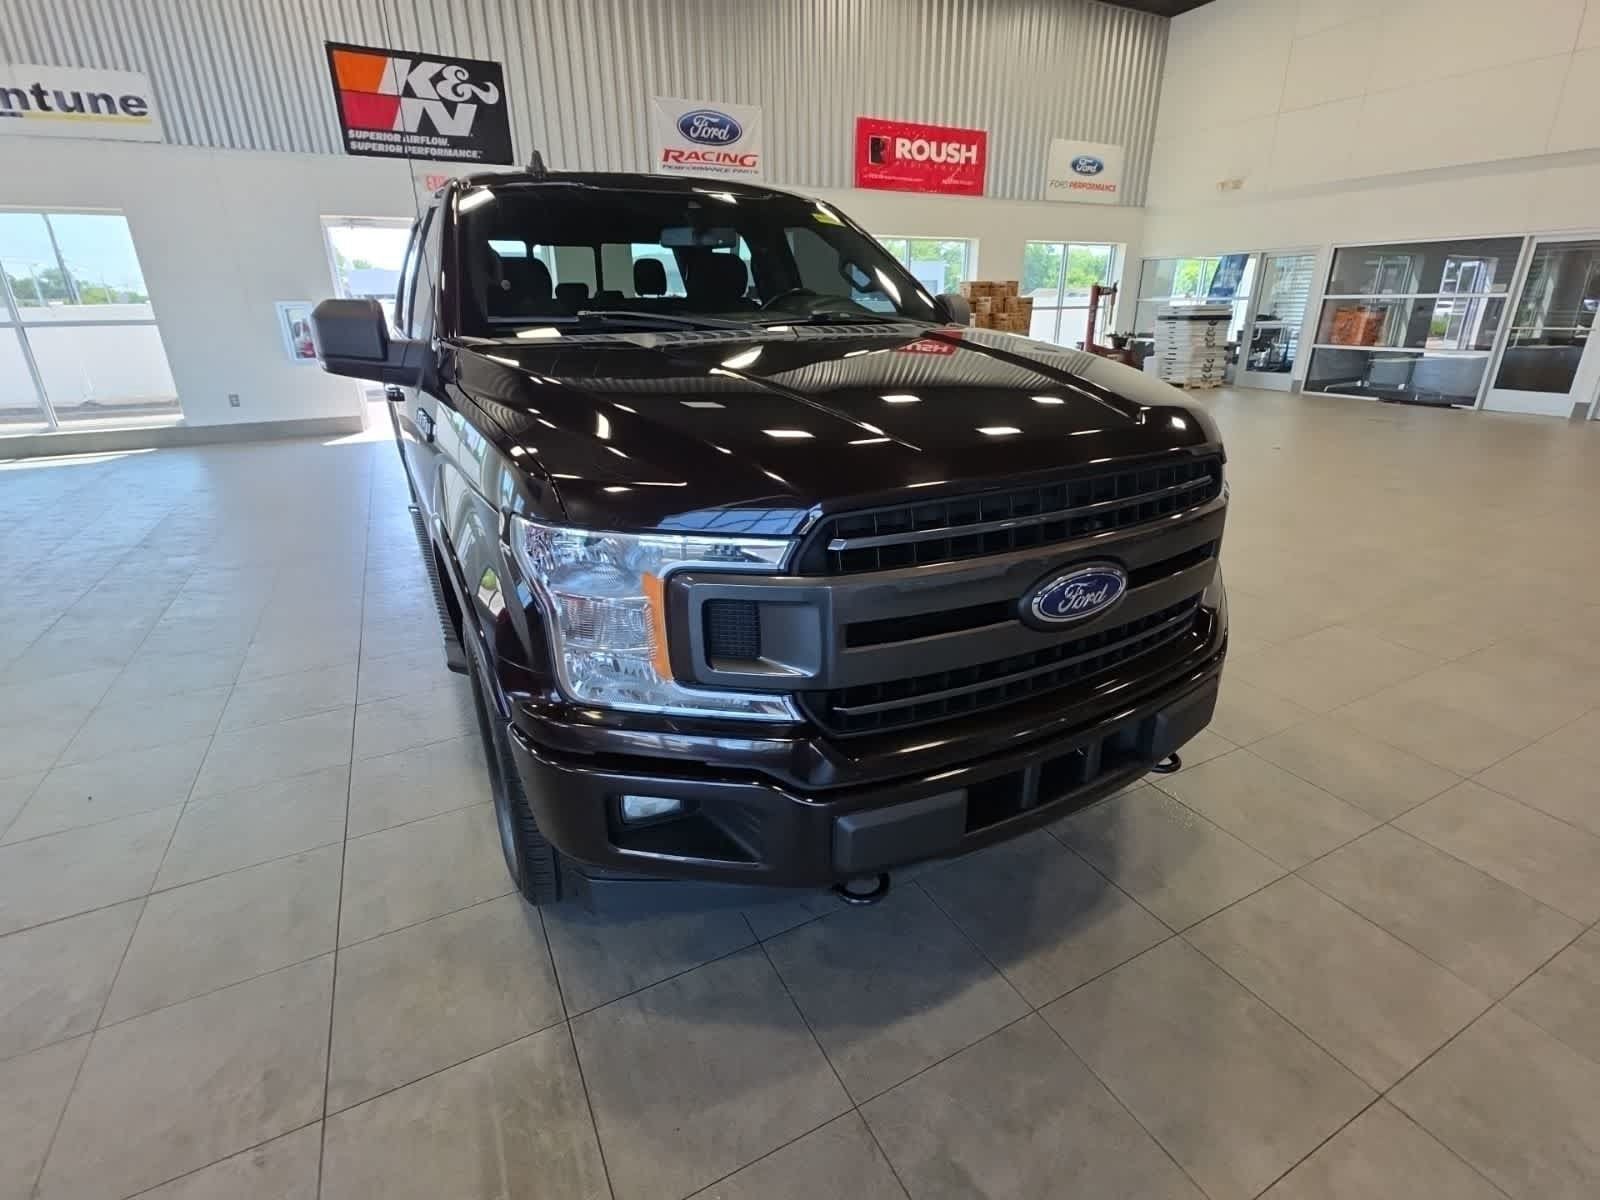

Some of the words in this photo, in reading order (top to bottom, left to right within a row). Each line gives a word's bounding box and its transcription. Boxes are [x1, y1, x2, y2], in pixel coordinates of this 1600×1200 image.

[348, 129, 402, 143] SUPERIOR
[690, 115, 731, 141] Ford
[350, 141, 403, 154] SUPERIOR
[662, 149, 759, 167] RACING
[895, 137, 978, 165] ROUSH
[1058, 582, 1109, 613] Ford
